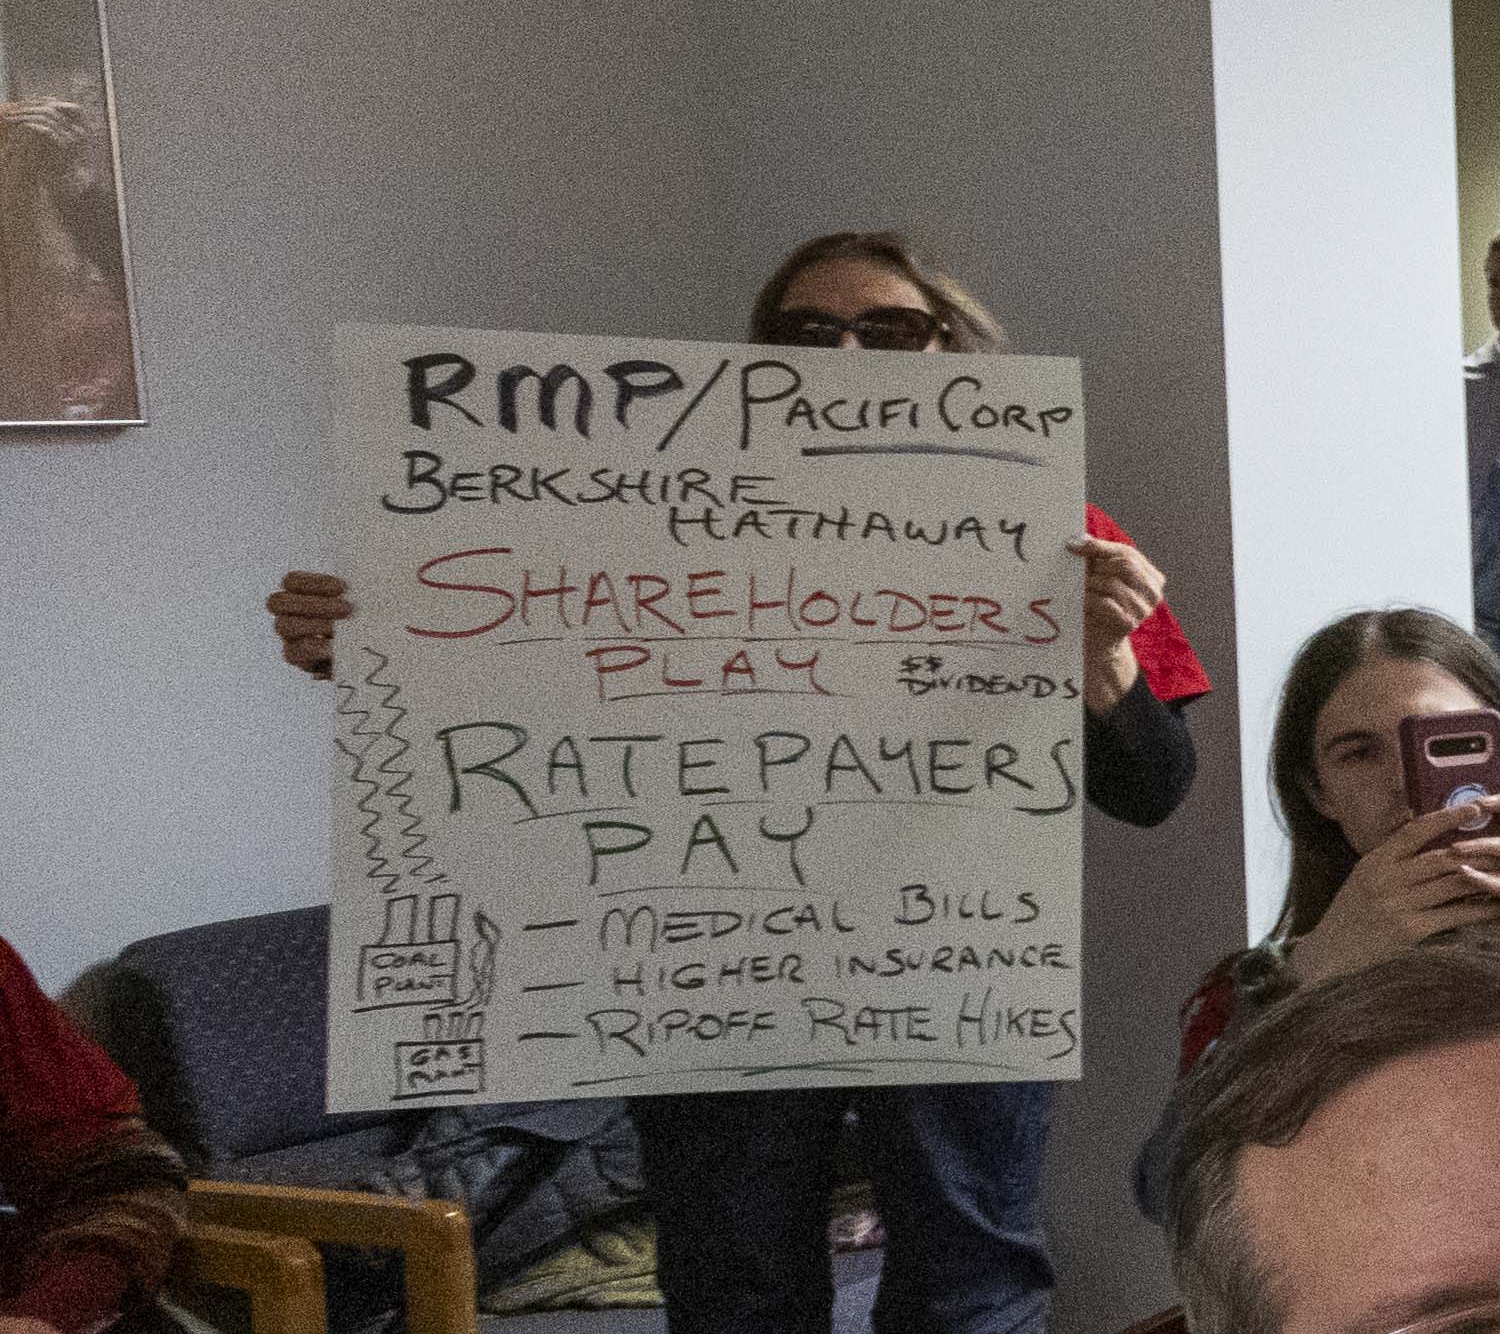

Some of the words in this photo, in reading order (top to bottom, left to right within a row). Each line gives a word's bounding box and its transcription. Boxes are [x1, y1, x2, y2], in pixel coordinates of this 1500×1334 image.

[381, 450, 785, 513] BERKSHIRE
[667, 505, 1030, 561] HATHAWAY
[584, 644, 832, 699] PLAY
[898, 674, 1080, 698] DIVIDENDS
[583, 806, 814, 885] PAY
[600, 904, 857, 952] MEDICAL
[896, 883, 1041, 926] BILLS
[613, 954, 804, 996] HIGHER
[834, 942, 1073, 978] INSURANCE
[800, 996, 938, 1046] RATE
[956, 985, 1078, 1060] HIKES
